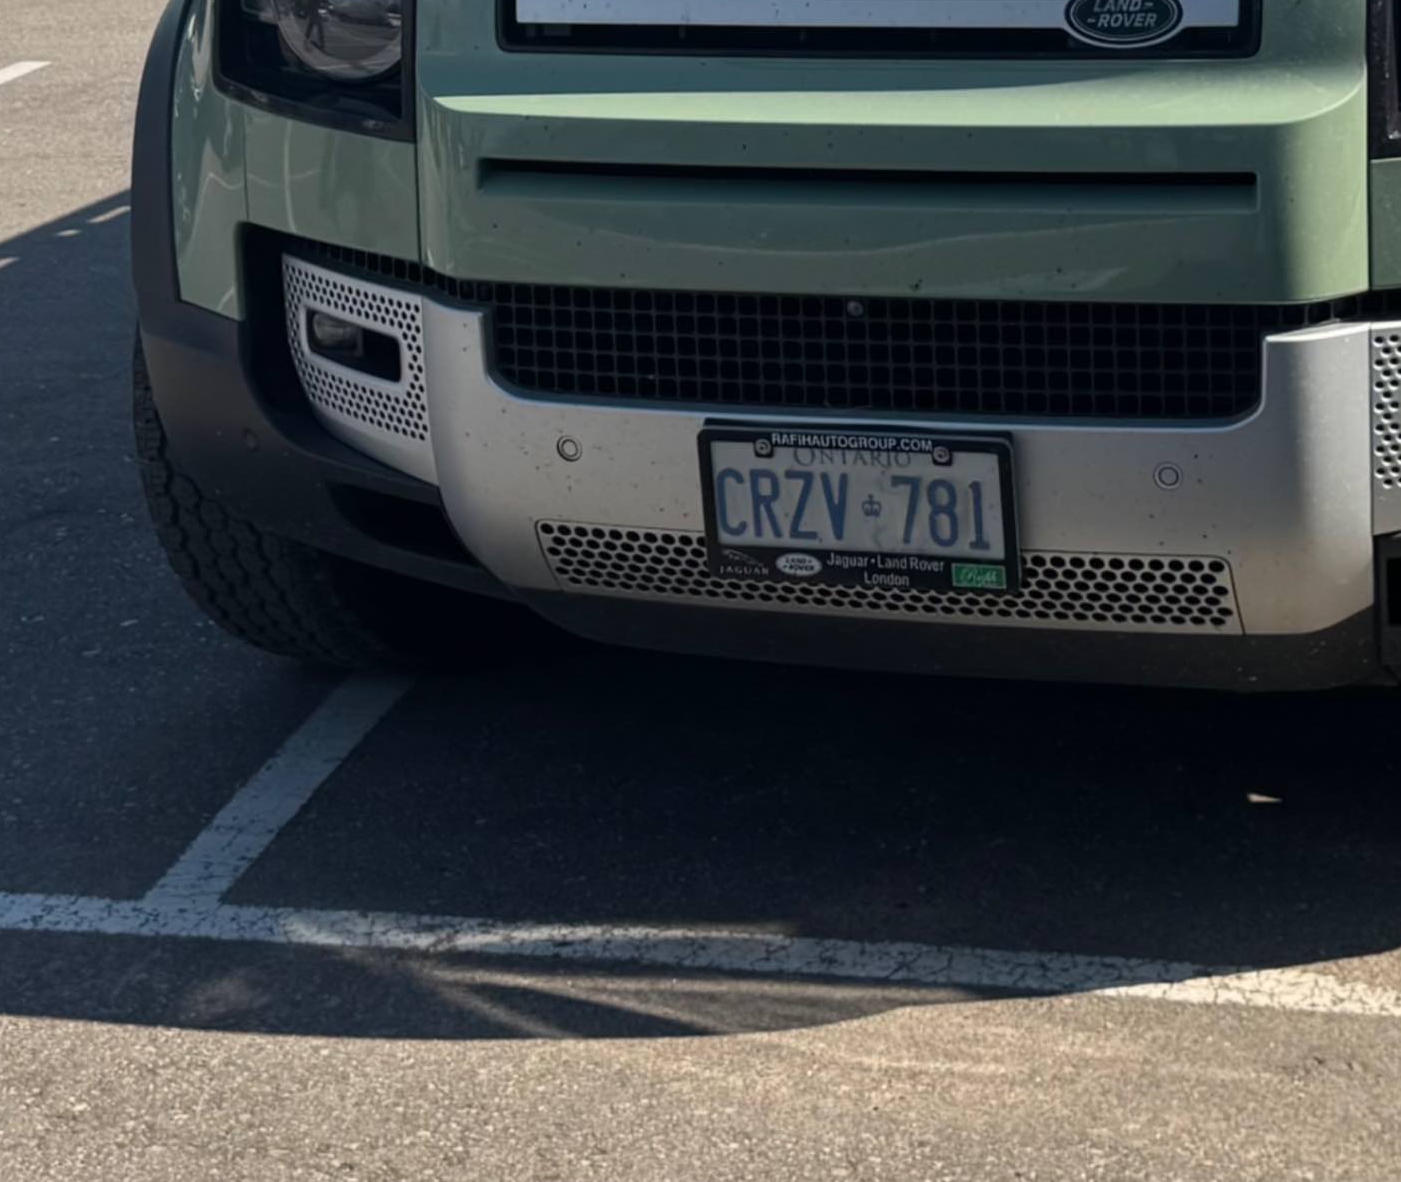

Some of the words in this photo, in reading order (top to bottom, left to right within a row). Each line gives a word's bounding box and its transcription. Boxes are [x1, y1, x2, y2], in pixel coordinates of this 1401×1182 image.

[771, 432, 933, 451] RAFIHAUTOGROUP.COM
[793, 447, 912, 468] ONTARIO
[715, 467, 849, 541] CRZV
[891, 474, 991, 551] 781
[825, 551, 869, 569] Jaguar
[877, 554, 908, 569] Land
[909, 556, 946, 572] Rover
[863, 570, 910, 587] London
